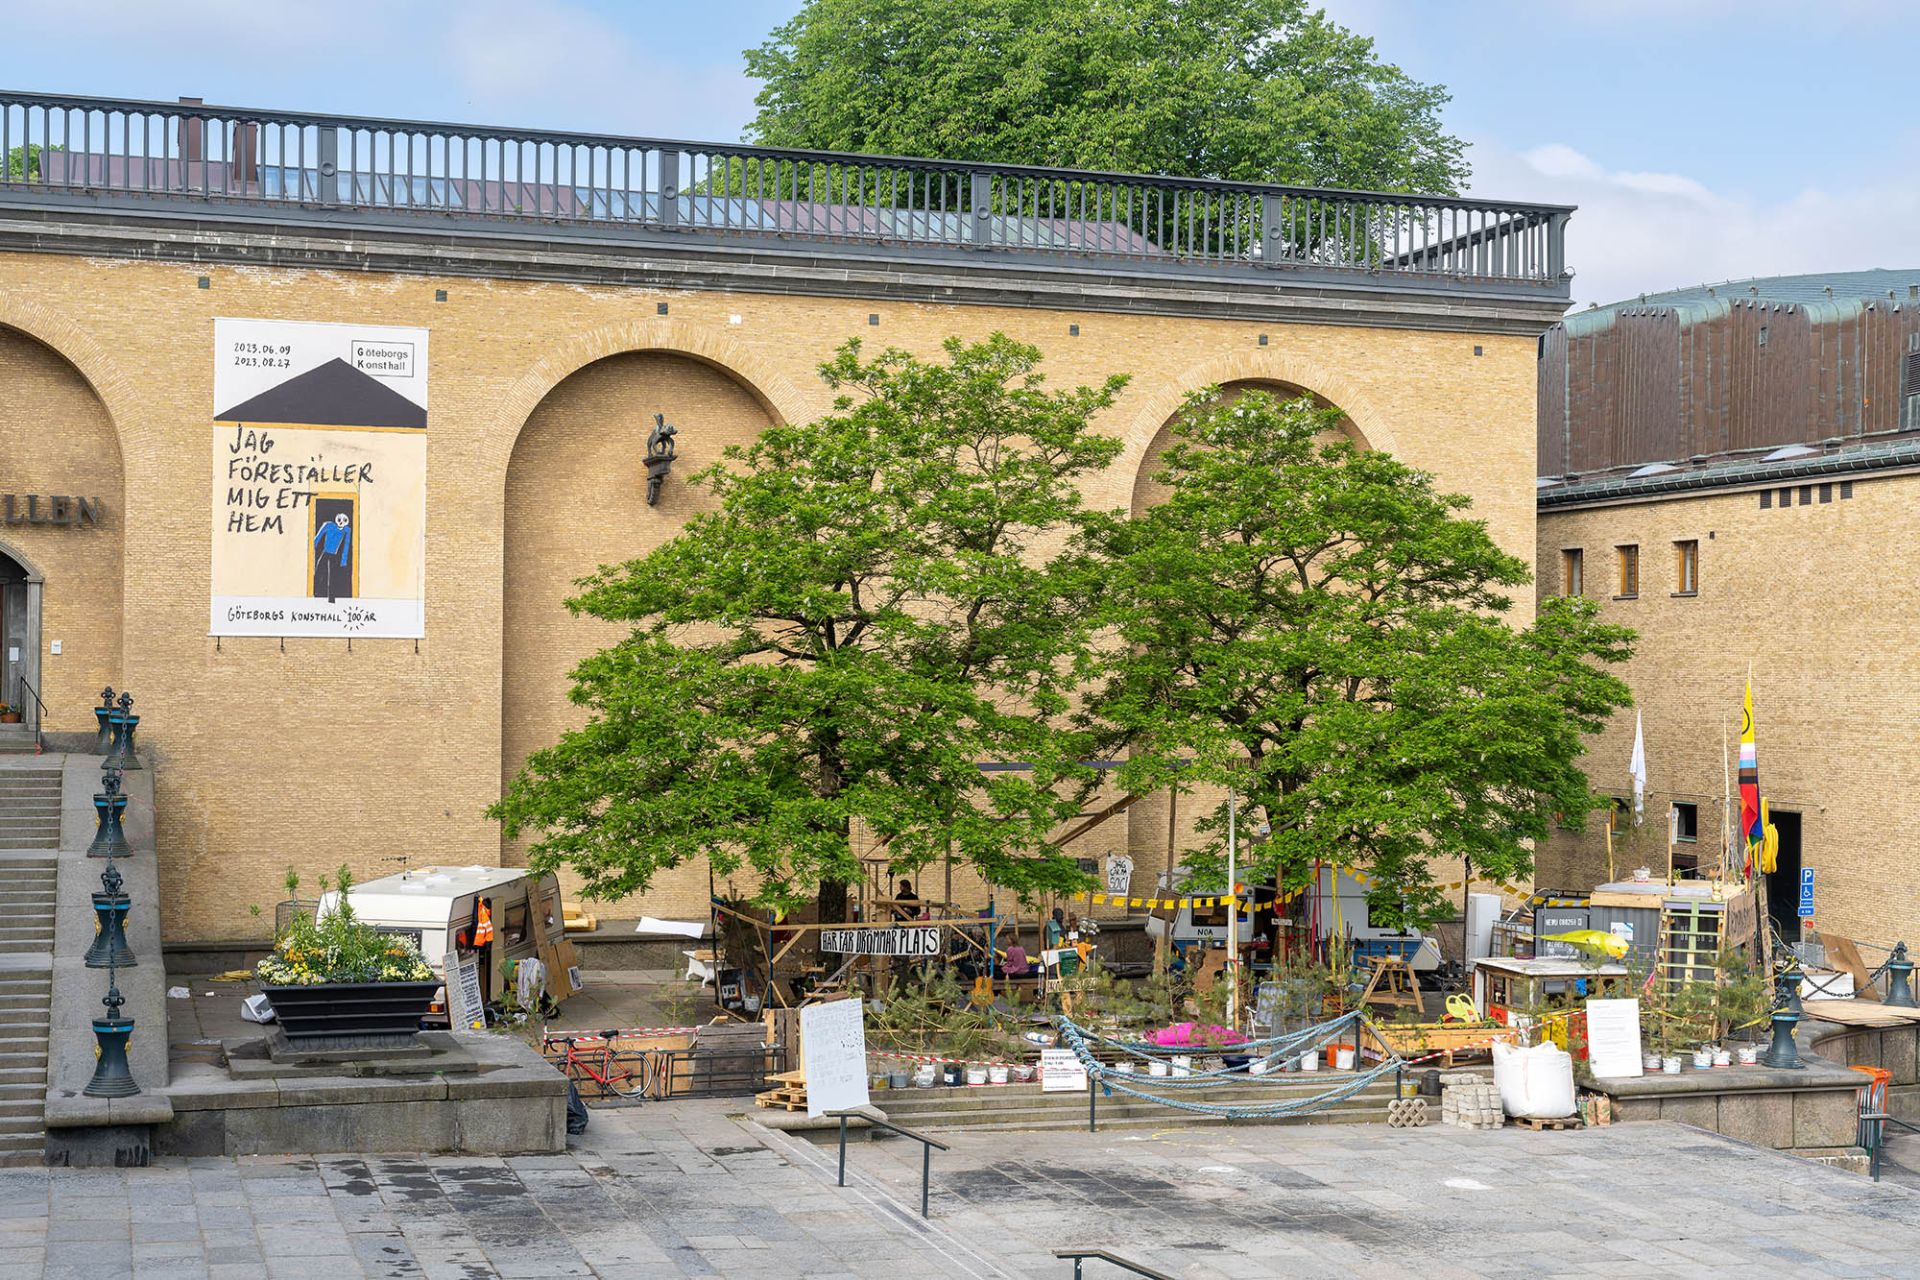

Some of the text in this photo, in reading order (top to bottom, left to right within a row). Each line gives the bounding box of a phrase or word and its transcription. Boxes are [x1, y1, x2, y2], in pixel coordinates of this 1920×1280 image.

[234, 342, 291, 355] 2023.06.09
[234, 356, 291, 368] 2023.08.27
[229, 423, 275, 454] JAG
[228, 453, 374, 484] FÖRESTÄLLER
[227, 487, 318, 509] MIG ETT
[227, 511, 284, 534] HEM
[227, 605, 285, 622] GÖTEBORGS
[290, 610, 342, 623] KONSTHALL
[363, 610, 377, 622] ÅR
[1804, 870, 1812, 882] P
[856, 930, 897, 954] DRÖMMAR
[900, 929, 938, 954] PLATS
[1198, 928, 1214, 936] NOA
